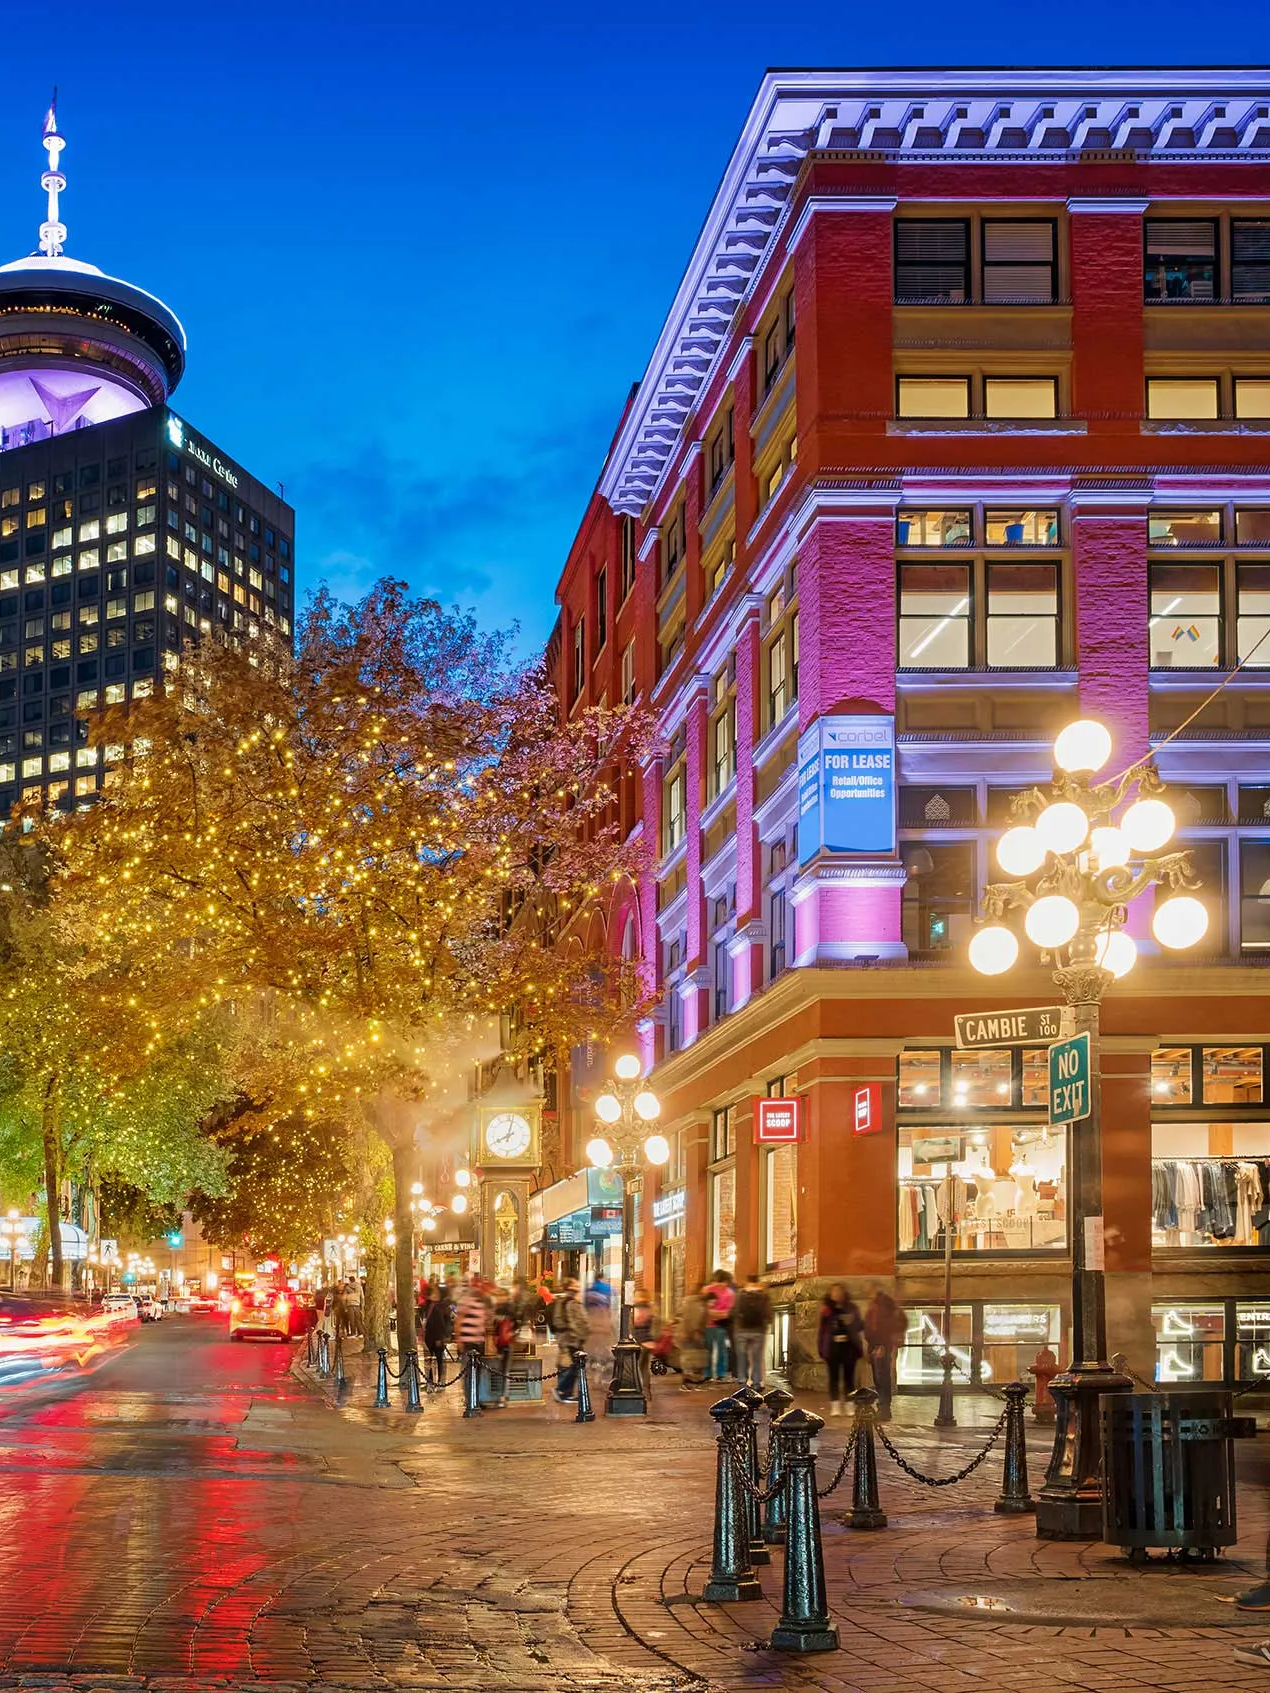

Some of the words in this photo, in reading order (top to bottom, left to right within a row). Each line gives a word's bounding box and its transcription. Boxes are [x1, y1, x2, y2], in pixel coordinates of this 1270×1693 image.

[838, 729, 888, 742] corbel
[825, 755, 849, 769] FOR
[852, 755, 891, 769] LEASE
[832, 776, 883, 786] Retail/Office
[830, 788, 886, 799] Opportunities
[966, 1016, 1028, 1042] CAMBIE
[1039, 1014, 1050, 1026] ST
[1039, 1024, 1057, 1036] 100
[1058, 1049, 1079, 1081] NO
[1053, 1080, 1085, 1114] EXIT
[766, 1119, 791, 1128] SCOOP
